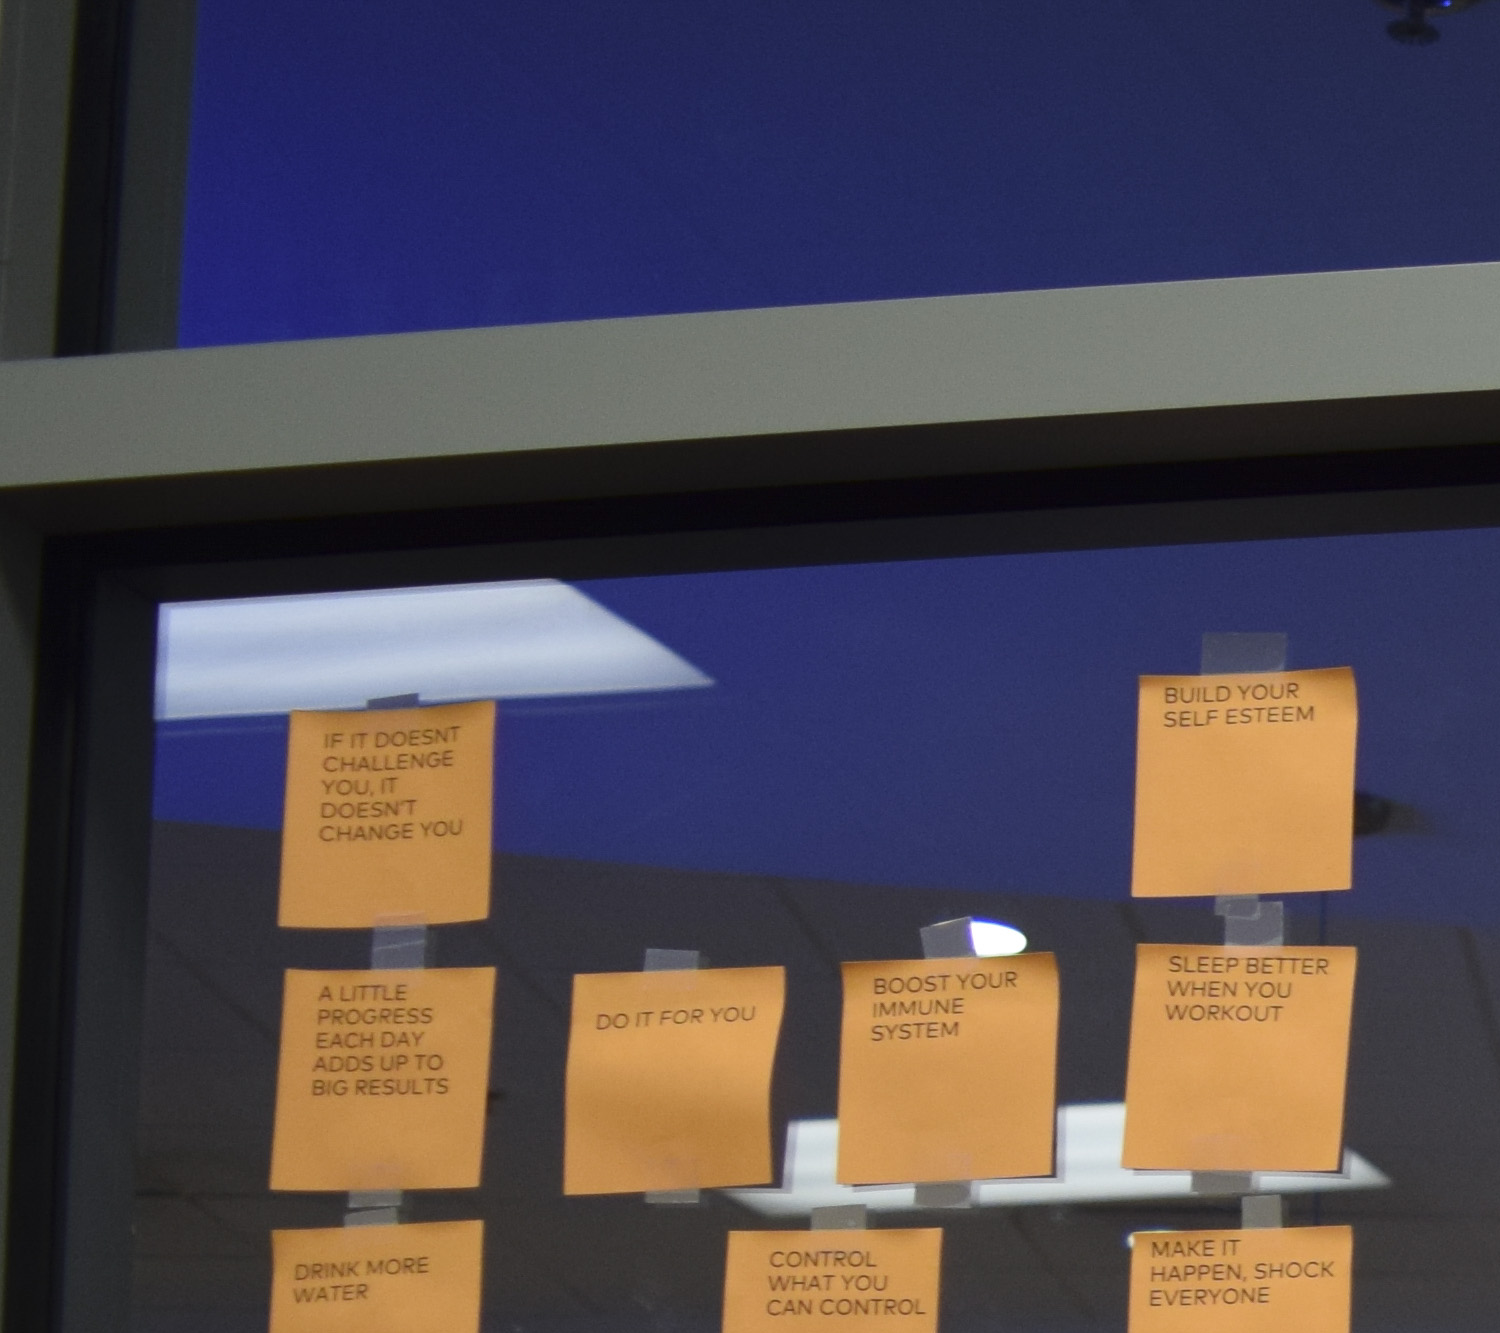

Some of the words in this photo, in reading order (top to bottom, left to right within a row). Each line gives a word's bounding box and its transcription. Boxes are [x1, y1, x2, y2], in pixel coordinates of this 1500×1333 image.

[1164, 684, 1232, 705] BUILD
[1236, 681, 1300, 701] YOUR
[1163, 708, 1219, 729] SELF
[1224, 704, 1315, 726] ESTEEM
[324, 732, 344, 749] IF
[350, 732, 369, 749] IT
[374, 725, 461, 749] DOESNT
[322, 749, 454, 773] CHALLENGE
[320, 778, 375, 797] YOU,
[380, 776, 399, 794] IT
[318, 821, 415, 843] CHANGE
[419, 819, 463, 838] YOU
[873, 973, 952, 996] BOOST
[955, 970, 1018, 991] YOUR
[872, 996, 965, 1018] IMMUNE
[870, 1020, 960, 1043] SYSTEM
[768, 1249, 878, 1269] CONTROL
[1151, 1239, 1215, 1258] MAKE
[1222, 1238, 1242, 1256] IT
[767, 1274, 837, 1292] WHAT
[840, 1274, 889, 1292] YOU
[1150, 1263, 1247, 1283] HAPPEN,
[1253, 1260, 1335, 1280] SHOCK
[766, 1298, 813, 1317] CAN
[818, 1298, 927, 1317] CONTROL
[1148, 1286, 1270, 1308] EVERYONE
